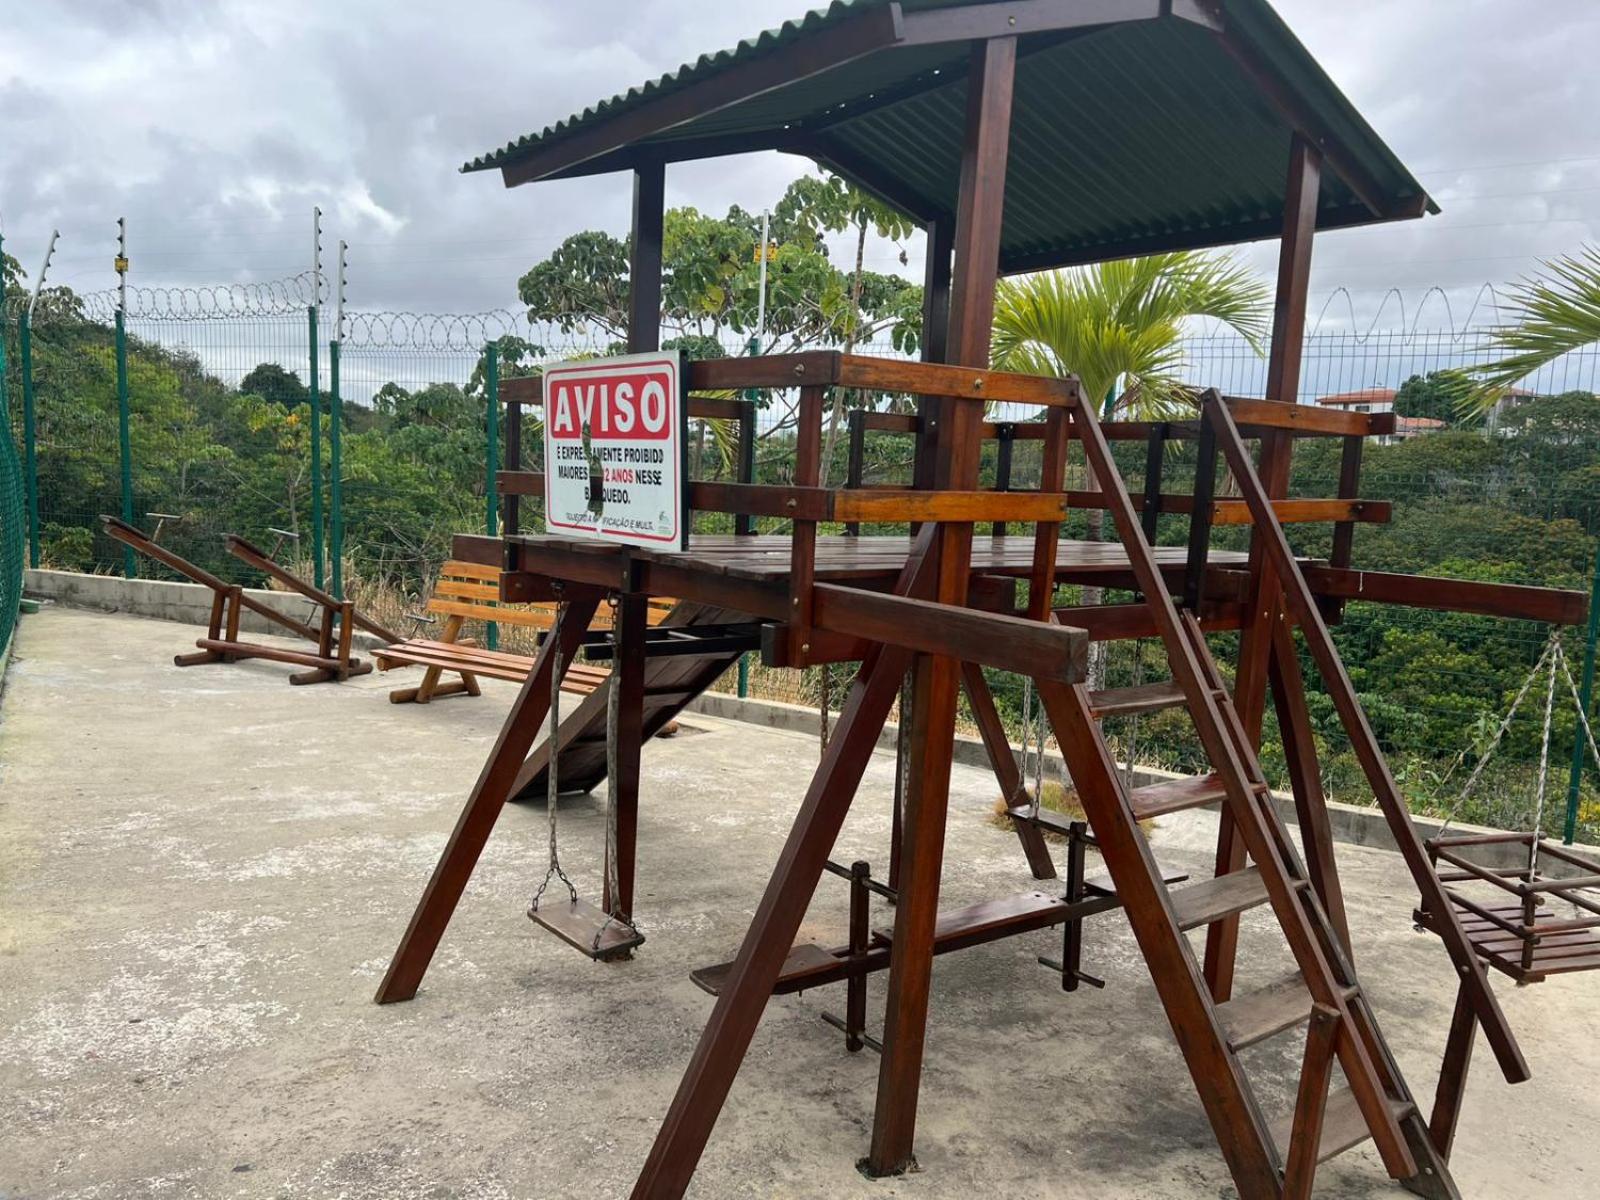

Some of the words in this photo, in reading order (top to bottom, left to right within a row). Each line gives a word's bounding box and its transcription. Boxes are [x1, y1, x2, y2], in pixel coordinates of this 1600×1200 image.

[553, 380, 666, 433] AVISO
[562, 446, 622, 462] EXPREAMENTE
[624, 447, 664, 464] PROIBIDO
[558, 465, 588, 480] MAIORES
[611, 468, 634, 483] ANOS
[635, 469, 662, 486] NESSE
[584, 486, 631, 504] BQUEDO.
